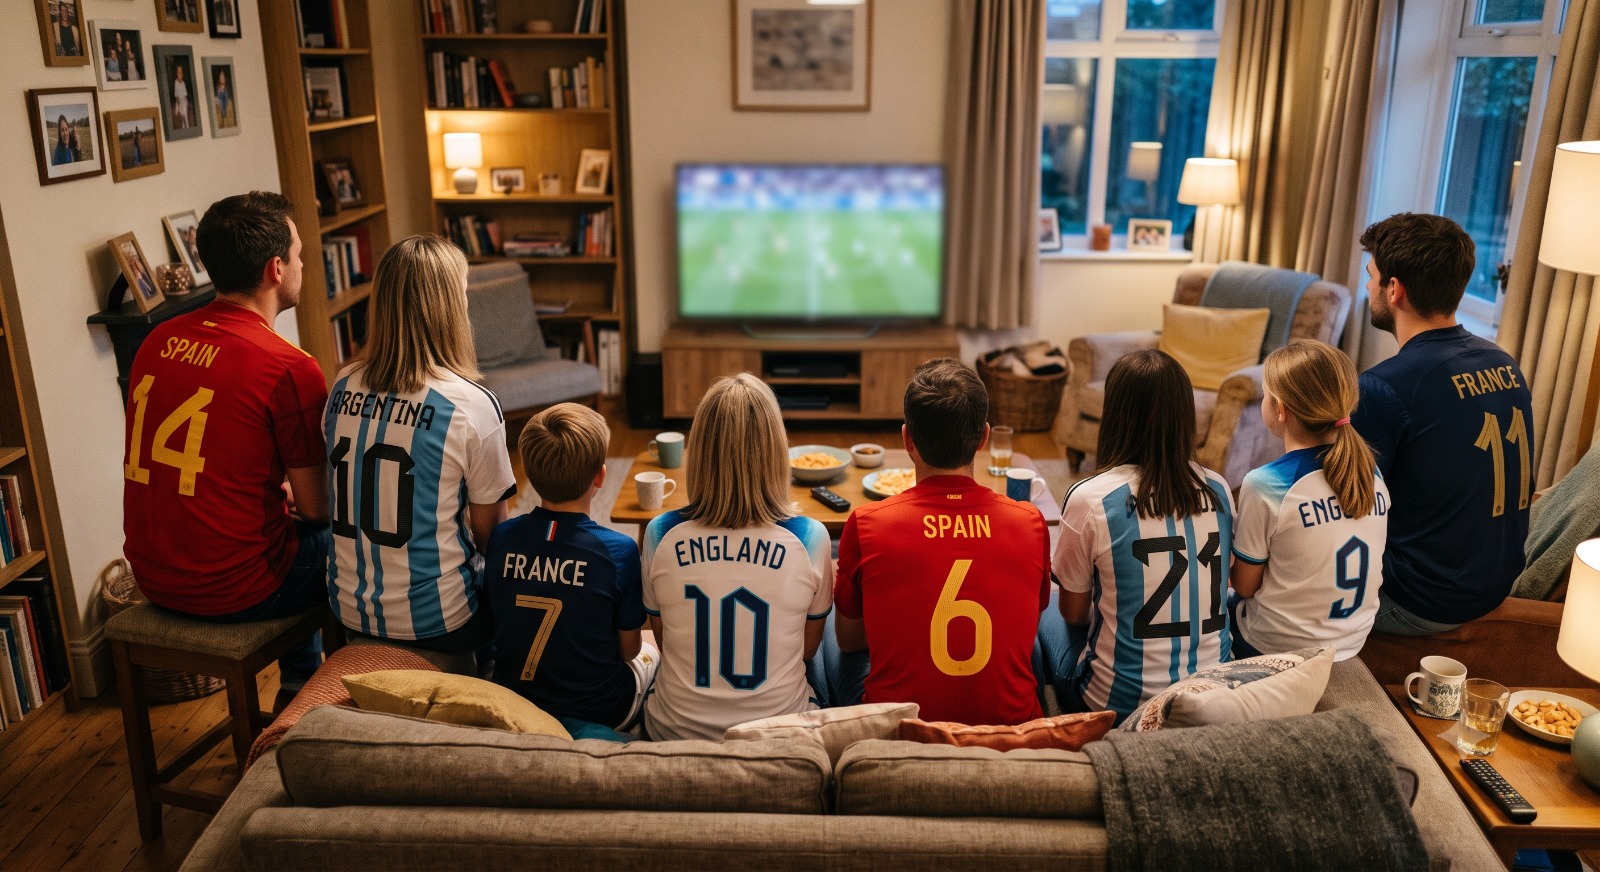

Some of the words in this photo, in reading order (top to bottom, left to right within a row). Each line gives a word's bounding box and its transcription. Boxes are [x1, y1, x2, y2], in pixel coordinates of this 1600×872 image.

[161, 337, 219, 368] SPAIN
[1451, 365, 1520, 400] FRANCE
[124, 374, 215, 497] 14
[330, 390, 436, 431] ARGENTINA
[329, 436, 416, 549] 10
[1474, 406, 1530, 517] 11
[675, 535, 786, 570] ENGLAND
[923, 514, 992, 539] SPAIN
[1298, 491, 1387, 528] ENGD
[503, 552, 588, 587] FRANCE
[1132, 532, 1227, 639] 21
[1328, 534, 1370, 620] 9
[515, 594, 563, 681] 7
[684, 584, 770, 691] 10
[930, 559, 993, 677] 6
